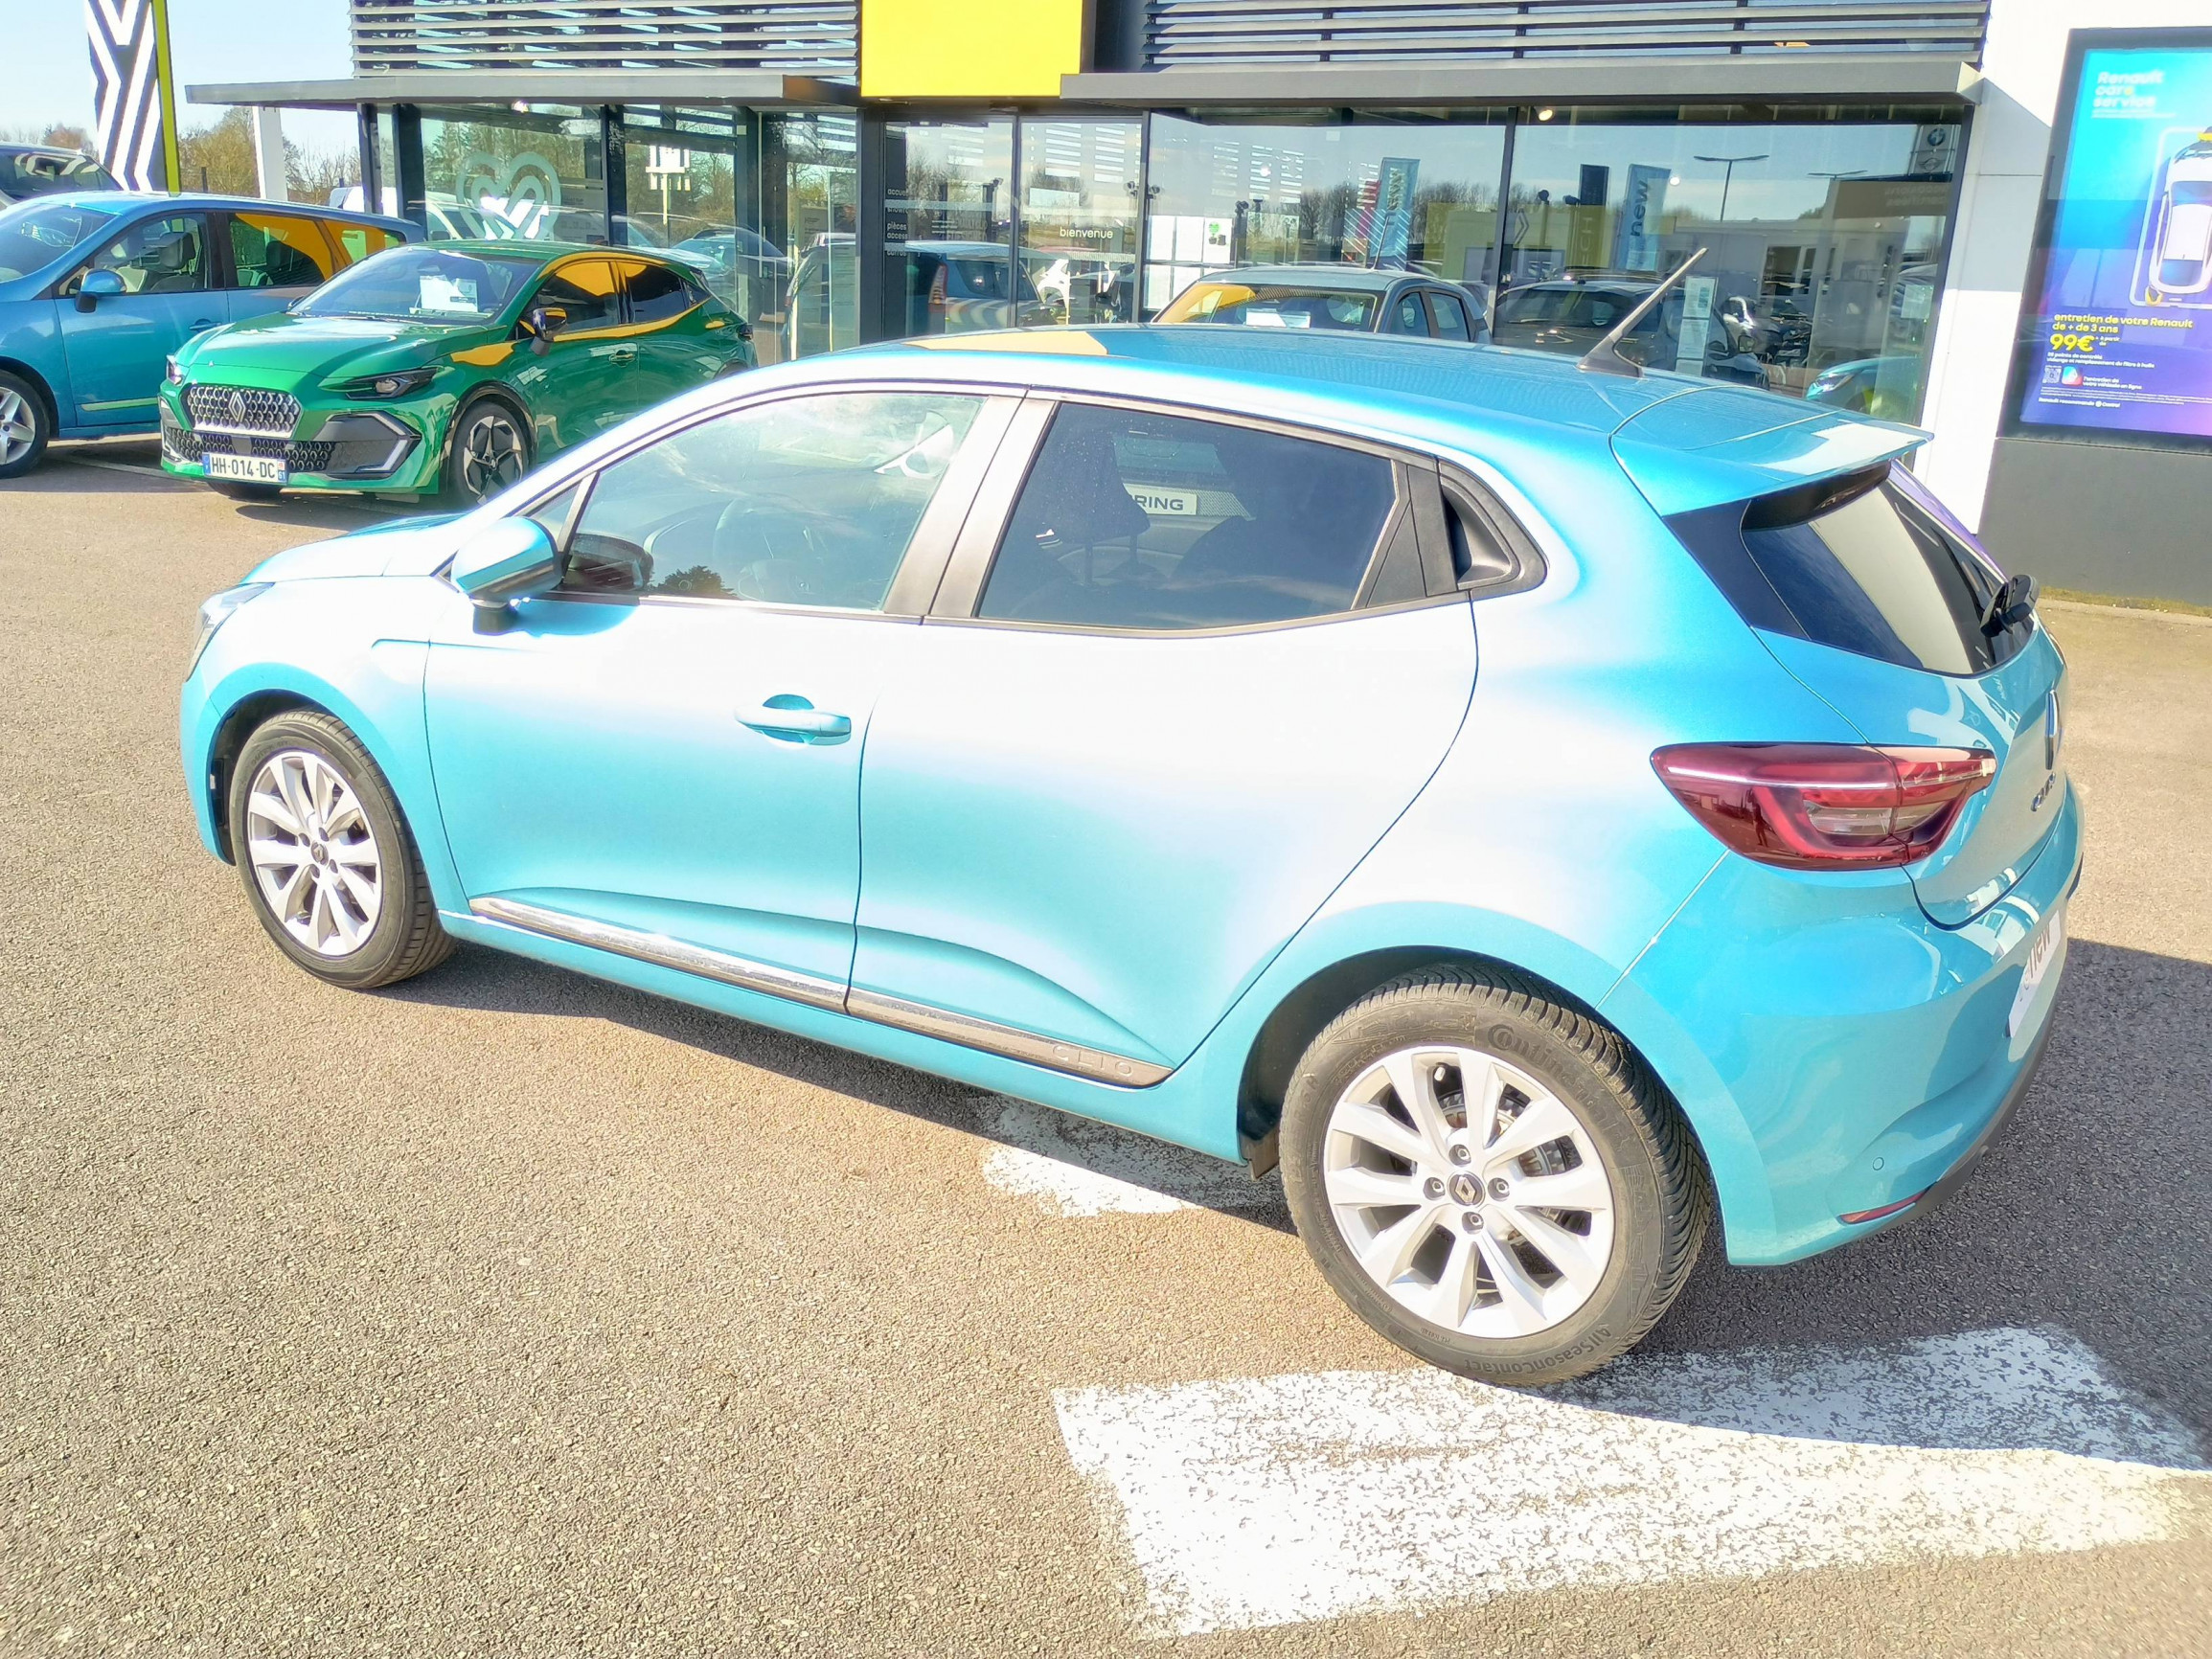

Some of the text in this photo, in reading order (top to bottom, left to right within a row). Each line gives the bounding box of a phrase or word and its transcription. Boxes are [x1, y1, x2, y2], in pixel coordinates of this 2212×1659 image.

[1060, 226, 1113, 239] bienvenue
[2052, 322, 2065, 331] de
[2075, 323, 2089, 332] de
[2090, 325, 2097, 333] 3
[2054, 313, 2193, 329] entretien de votre Renault
[211, 457, 275, 478] HH-014-DC
[1052, 1044, 1134, 1078] CLIO
